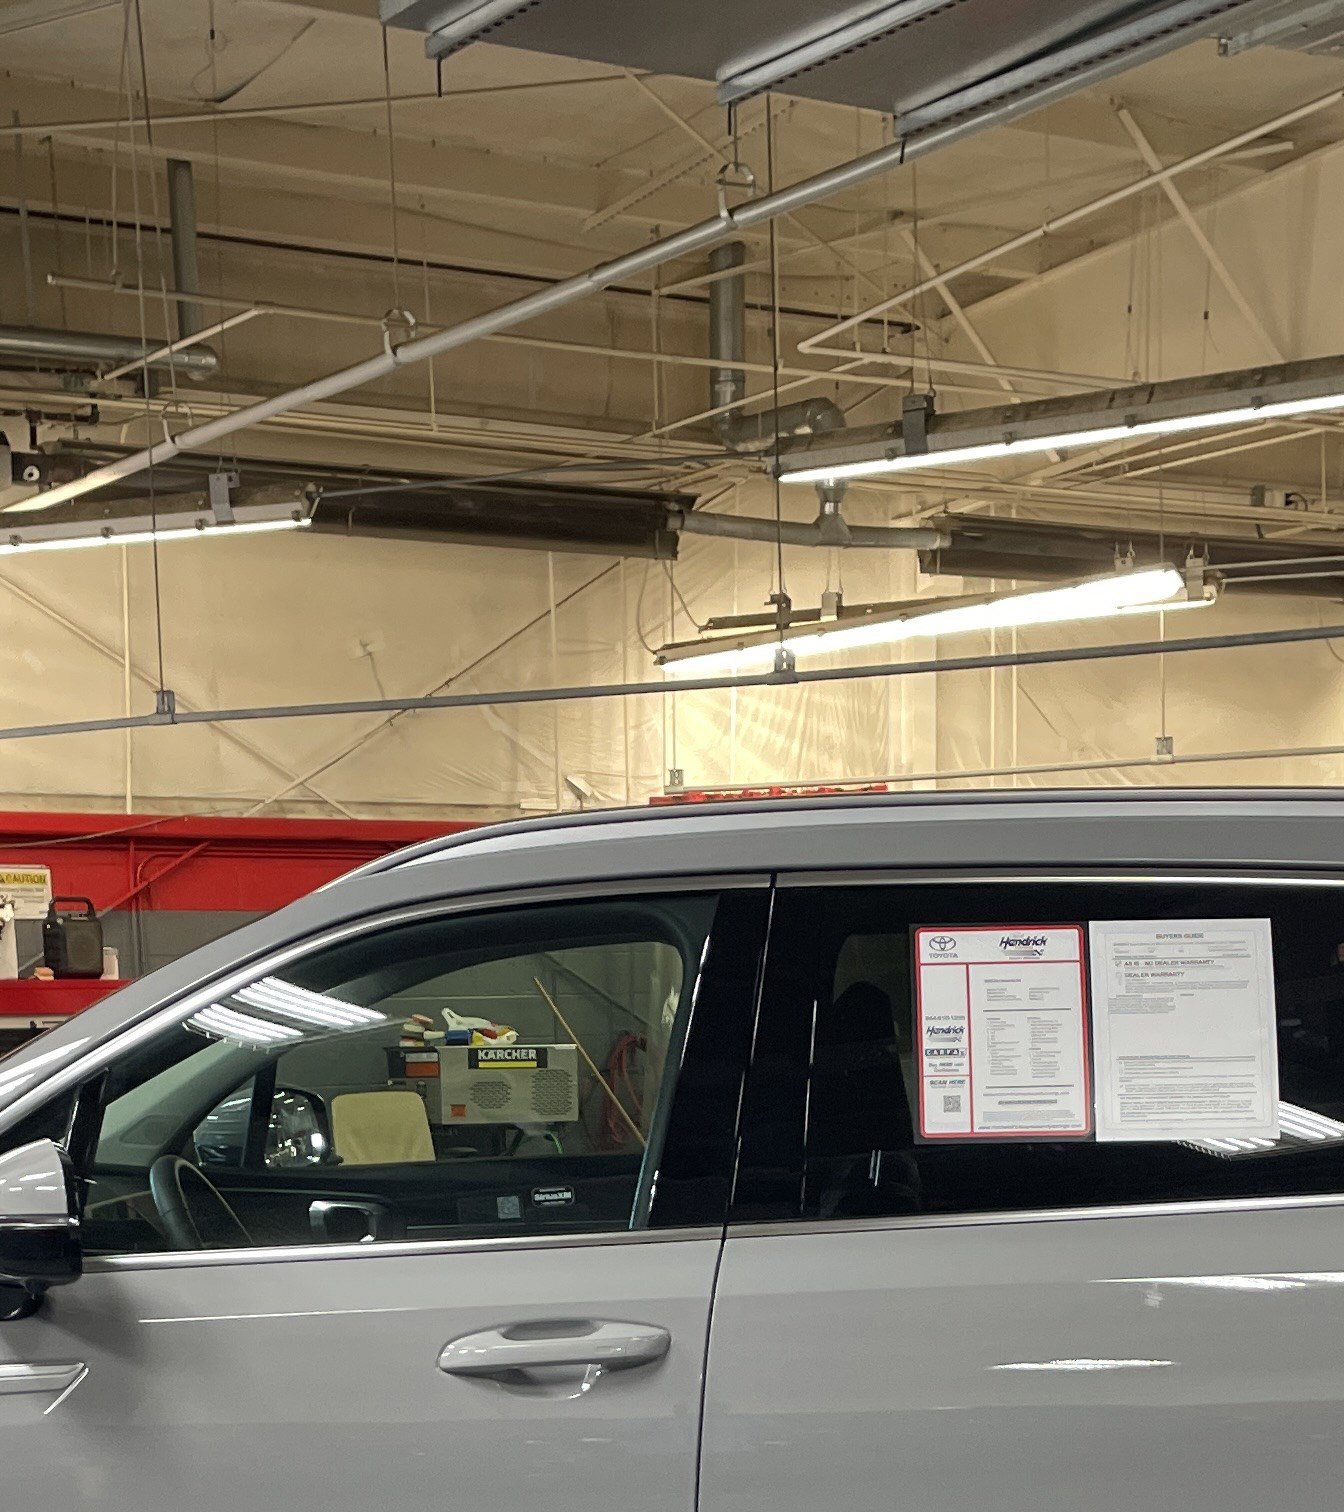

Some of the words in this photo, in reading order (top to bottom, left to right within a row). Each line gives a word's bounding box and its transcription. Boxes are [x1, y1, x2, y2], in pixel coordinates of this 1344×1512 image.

[5, 873, 46, 884] CAUTION
[998, 935, 1048, 950] Hendrick
[926, 1025, 965, 1037] Hendrick
[925, 1048, 967, 1057] CARFAX
